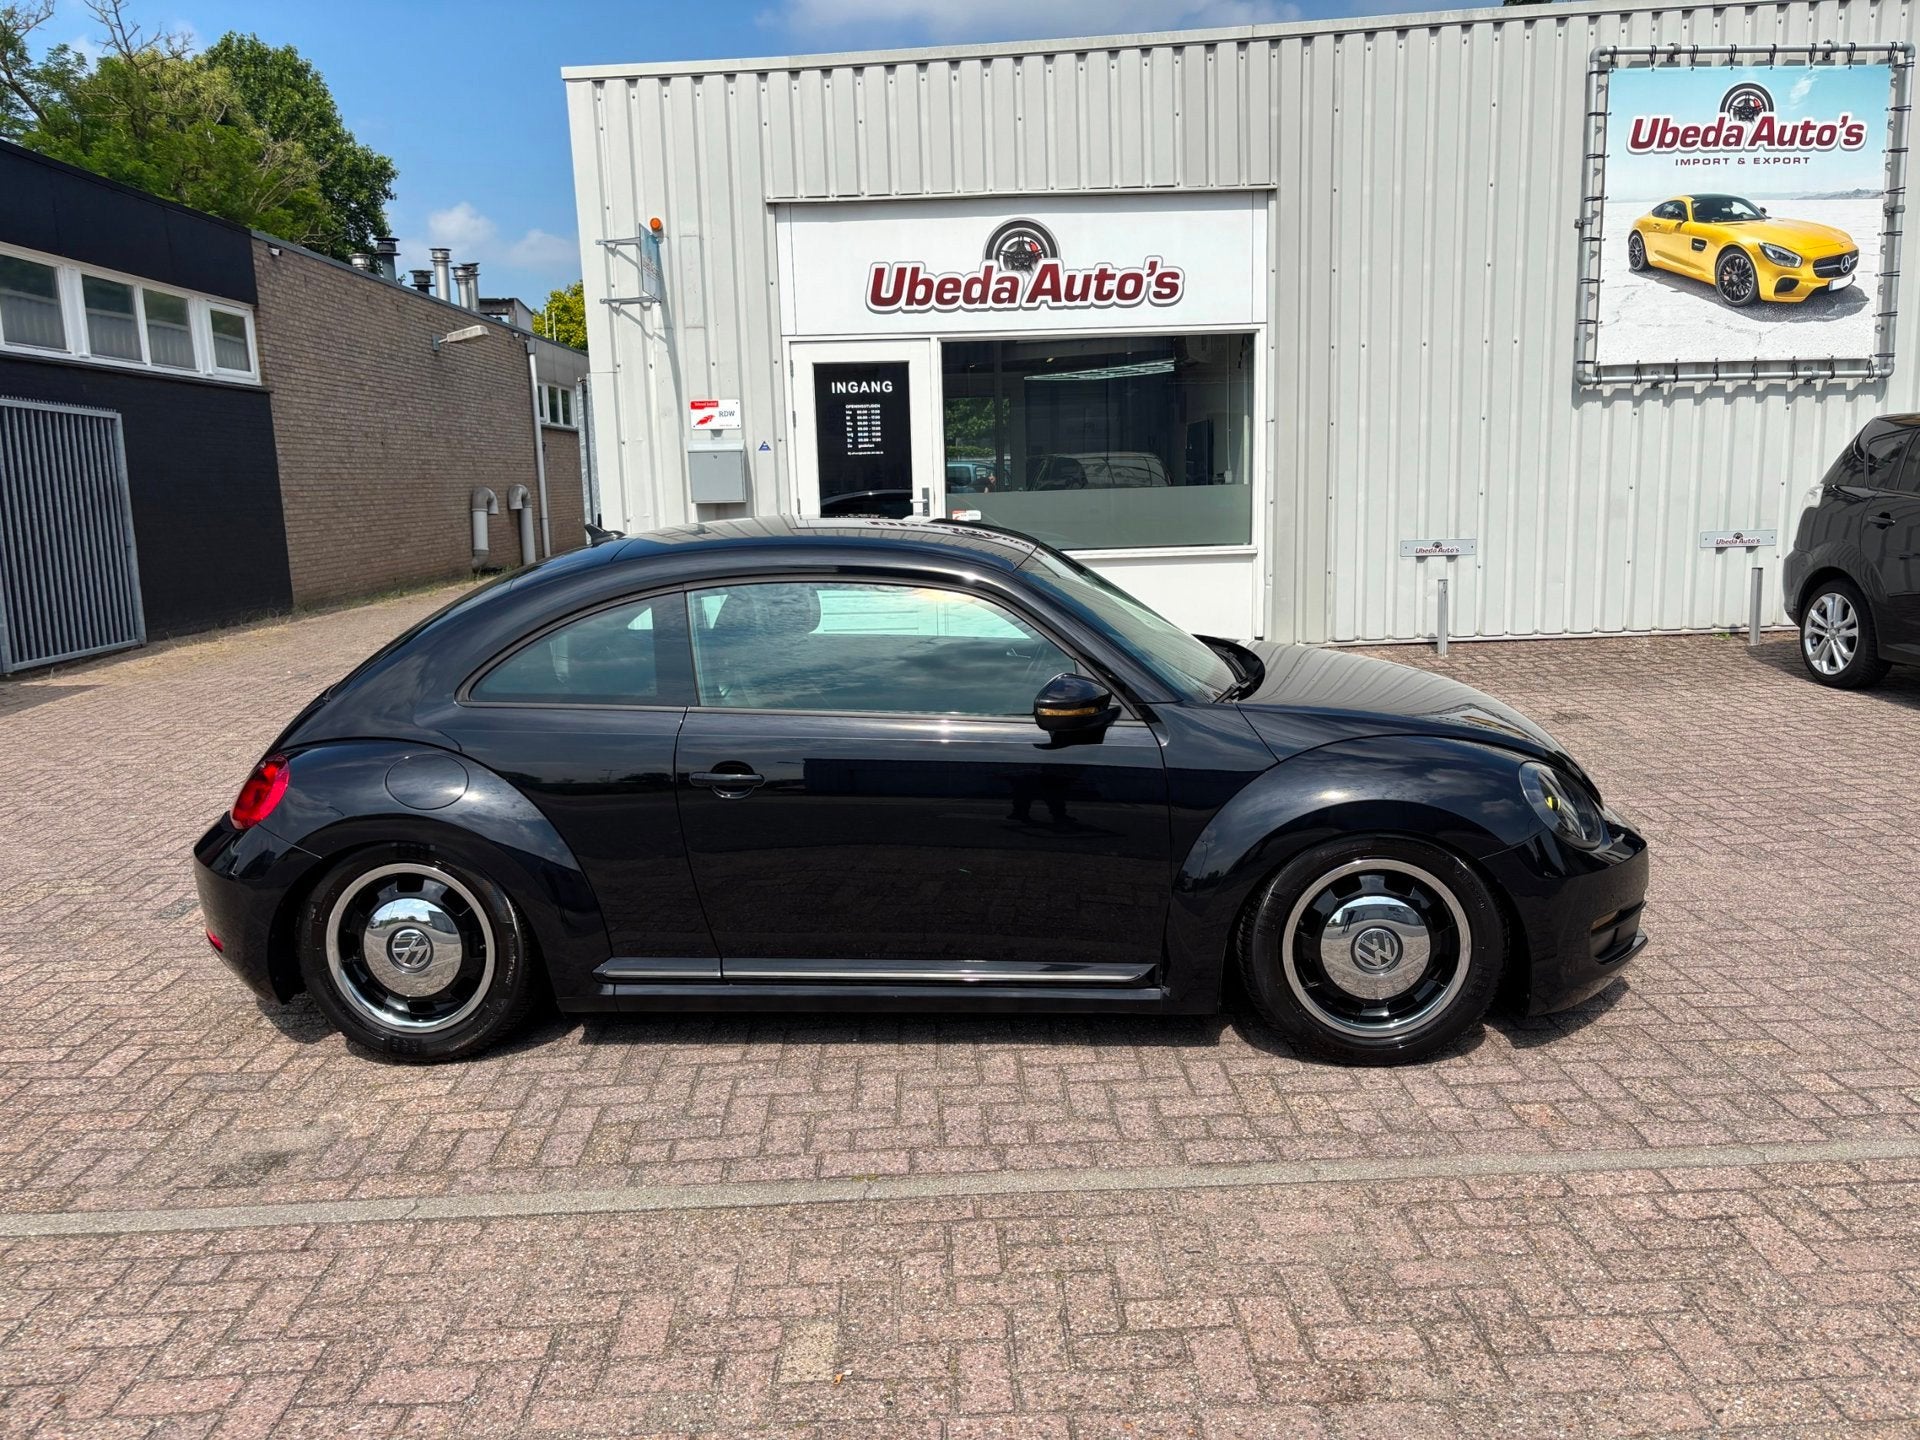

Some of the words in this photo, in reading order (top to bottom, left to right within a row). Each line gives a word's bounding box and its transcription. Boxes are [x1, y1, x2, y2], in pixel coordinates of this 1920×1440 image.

[1630, 116, 1743, 149] Ubeda
[1749, 115, 1864, 147] Auto's
[1675, 158, 1730, 166] IMPORT
[1737, 157, 1746, 165] &
[1753, 157, 1810, 165] EXPORT
[870, 265, 1020, 307] Ubeda
[1025, 260, 1180, 304] Auto's
[831, 381, 893, 394] INGANG
